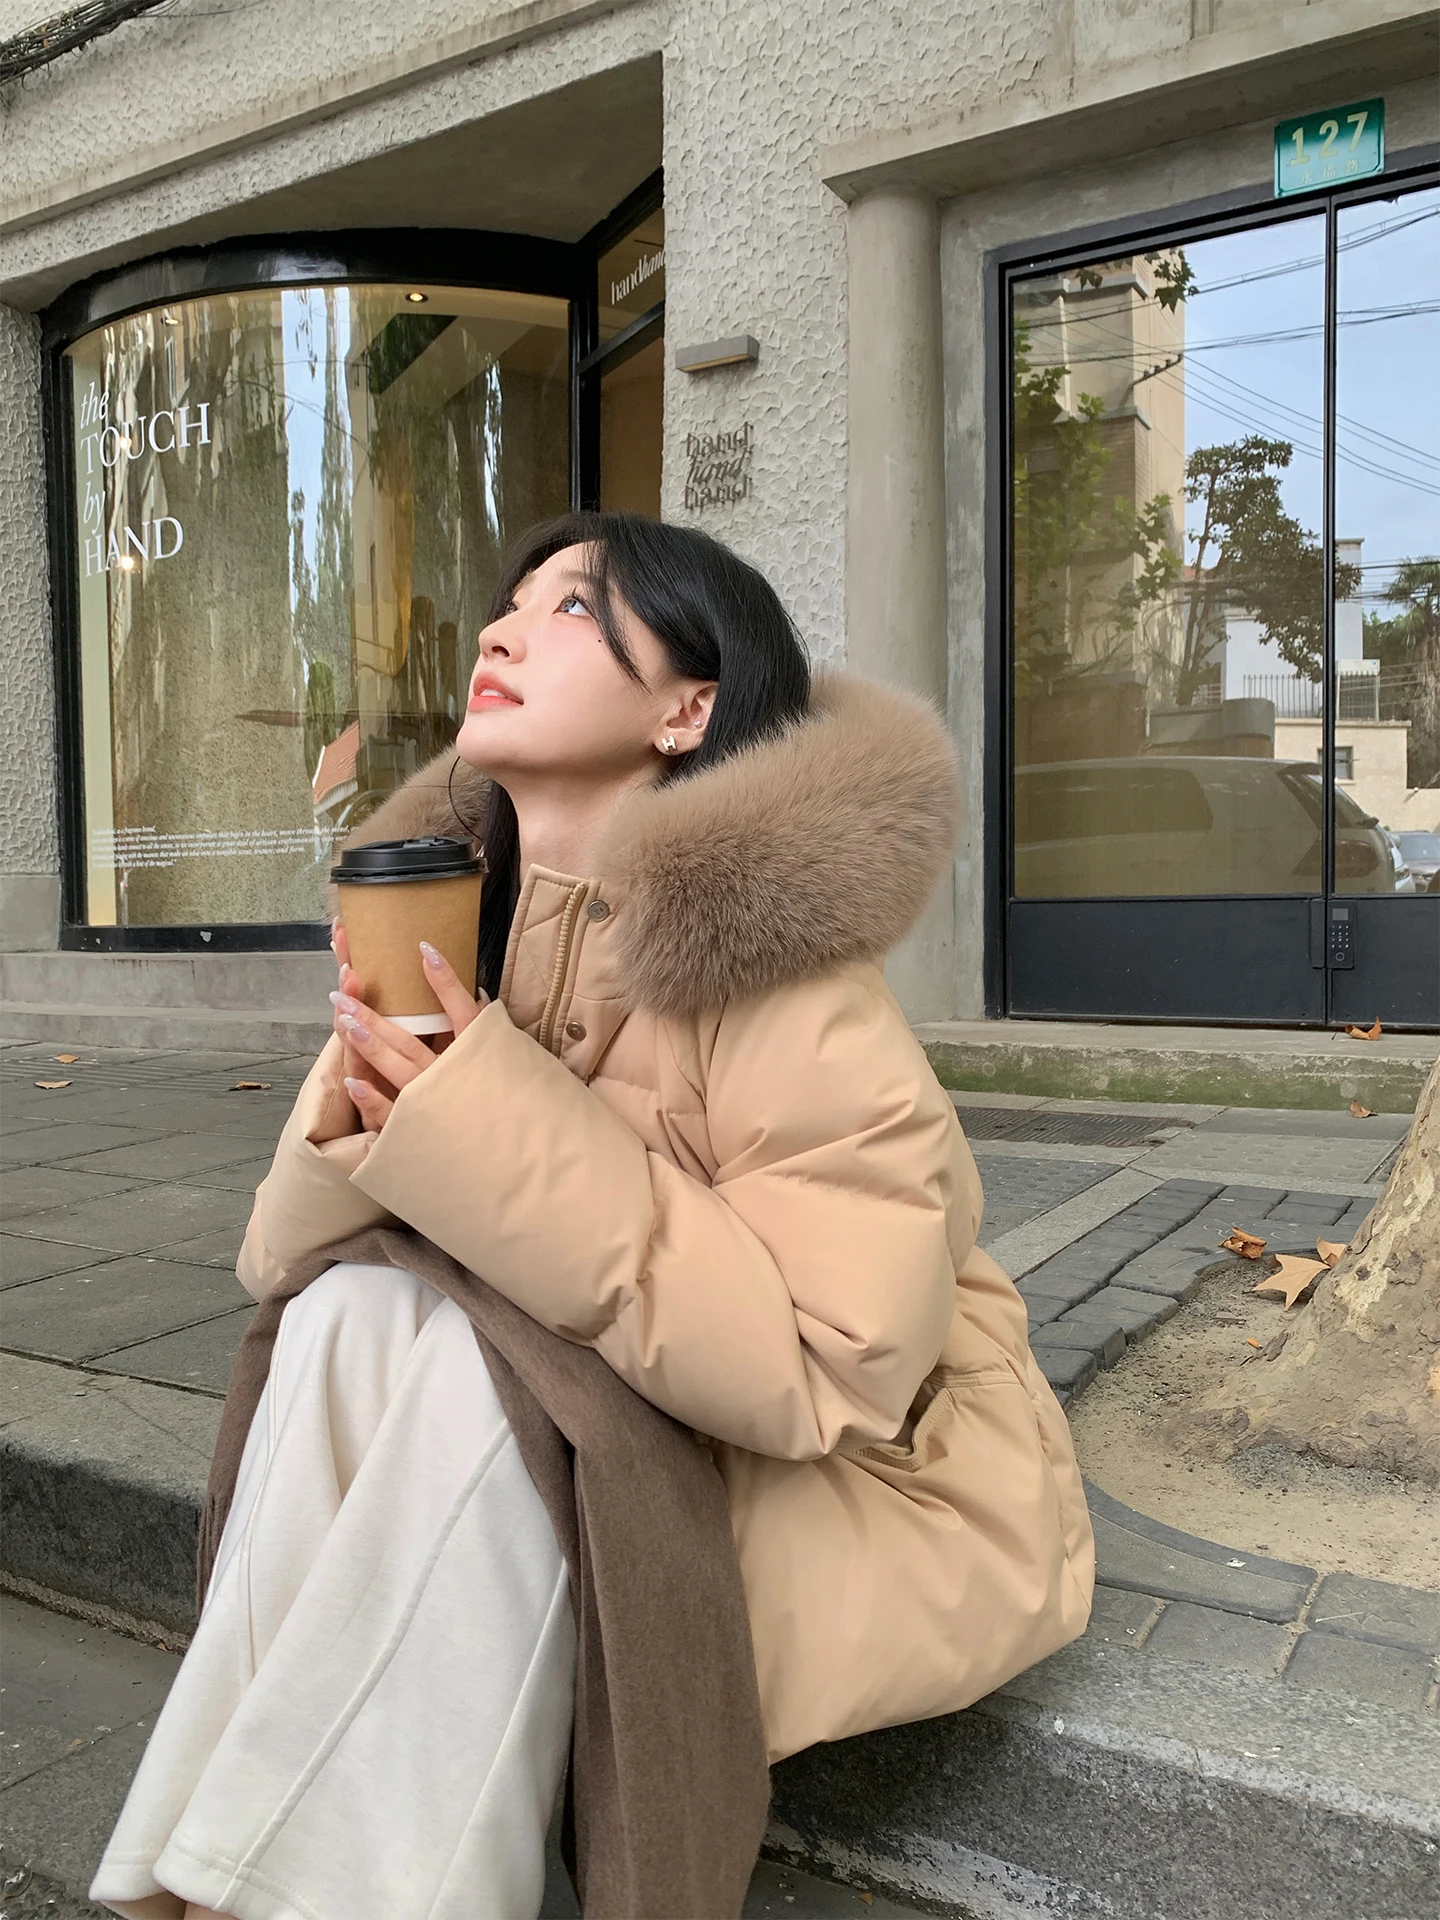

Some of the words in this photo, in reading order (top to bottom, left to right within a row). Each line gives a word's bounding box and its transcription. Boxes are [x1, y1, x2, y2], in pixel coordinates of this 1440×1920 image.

[1290, 112, 1368, 167] 127
[80, 381, 109, 429] the
[80, 402, 211, 475] TOUCH
[687, 421, 753, 457] hand
[83, 481, 105, 535] by
[685, 475, 752, 510] hand
[85, 516, 184, 577] HAND
[261, 829, 279, 837] heart,
